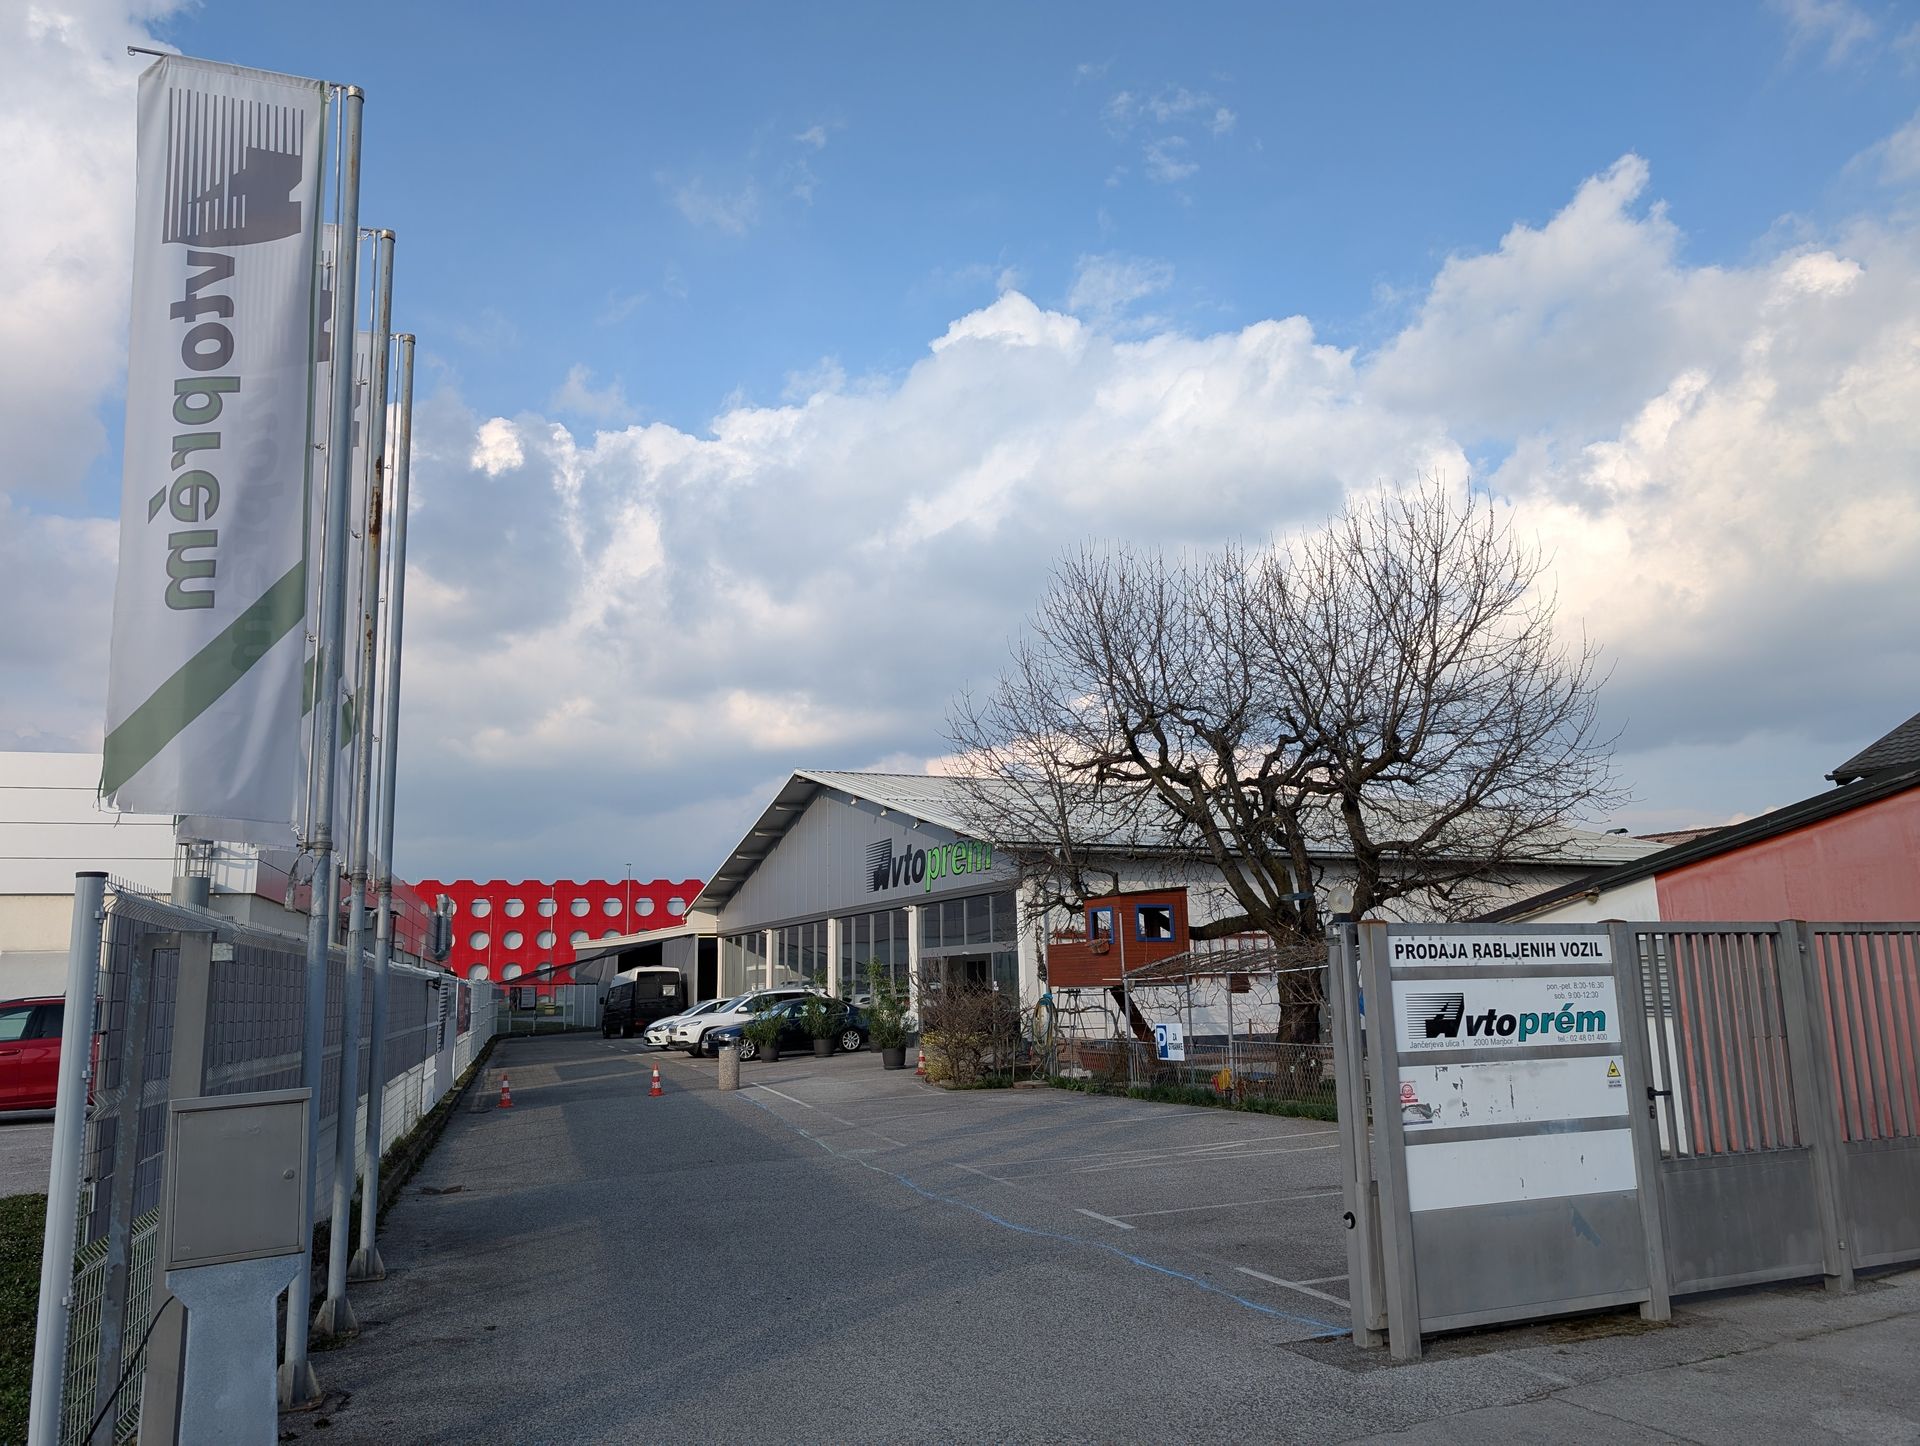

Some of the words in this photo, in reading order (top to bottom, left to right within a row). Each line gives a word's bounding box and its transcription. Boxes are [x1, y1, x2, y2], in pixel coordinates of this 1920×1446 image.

[1395, 943, 1468, 960] PRODAJA
[1472, 942, 1556, 959] RABLJENIH
[1560, 942, 1603, 957] VOZIL
[1445, 1039, 1460, 1048] ulica
[1473, 1038, 1489, 1047] 2000
